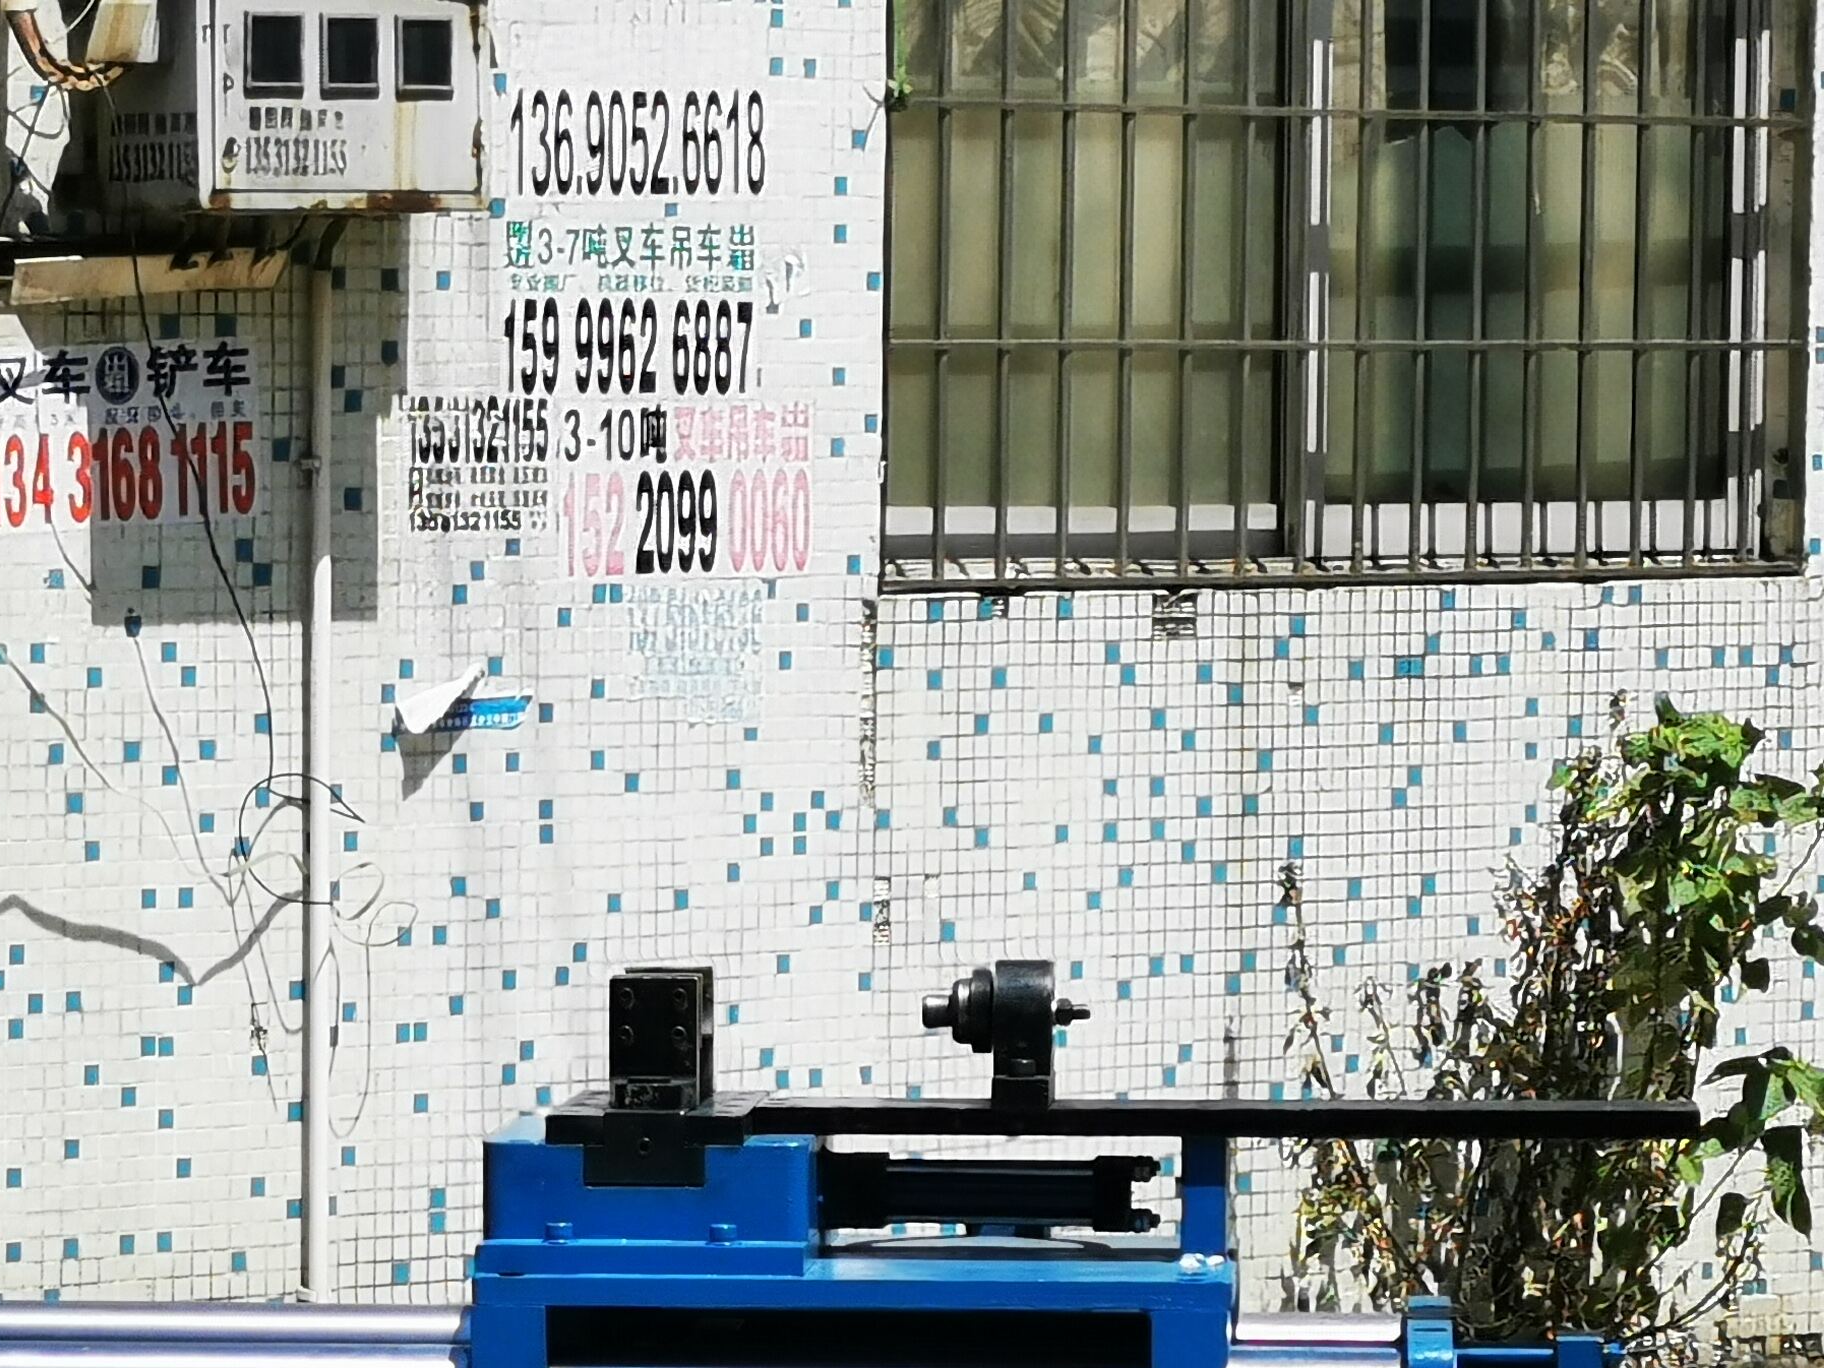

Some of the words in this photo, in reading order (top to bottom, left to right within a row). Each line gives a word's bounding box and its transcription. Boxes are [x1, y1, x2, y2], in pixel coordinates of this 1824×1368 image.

[511, 88, 765, 196] 136.9052.6618
[504, 297, 559, 395] 159
[575, 297, 657, 395] 9962
[672, 298, 754, 395] 6887
[635, 469, 718, 575] 2099
